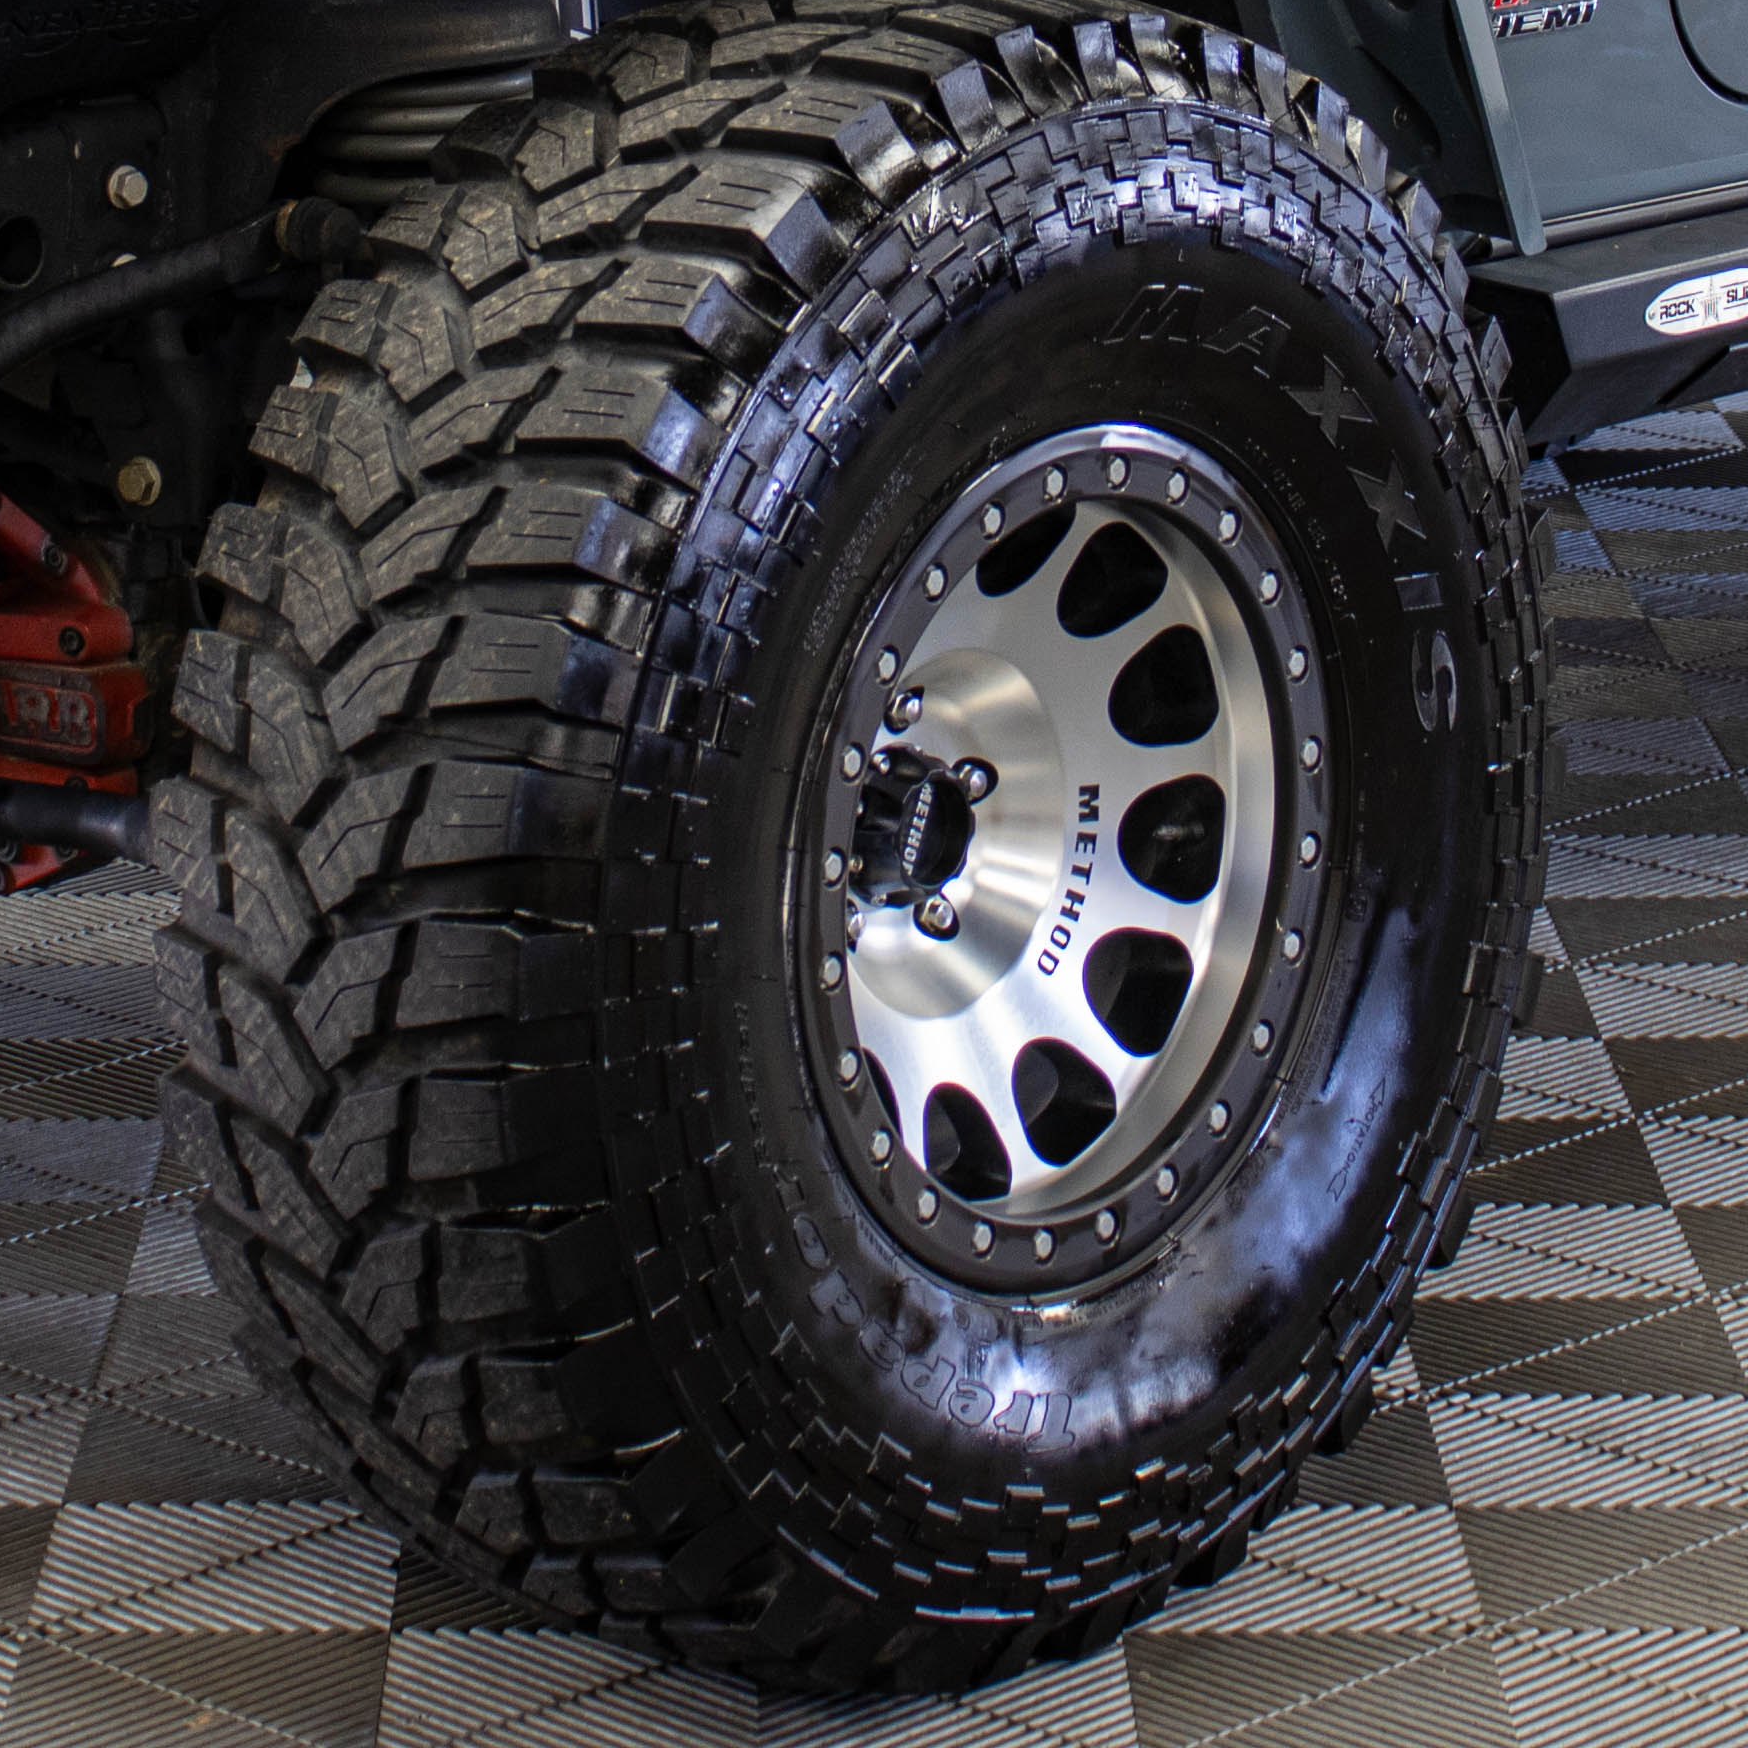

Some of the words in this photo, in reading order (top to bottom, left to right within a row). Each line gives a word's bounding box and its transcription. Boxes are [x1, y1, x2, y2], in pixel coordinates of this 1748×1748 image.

[1660, 299, 1695, 320] ROCK
[1100, 283, 1458, 734] MAXXIS
[1038, 784, 1100, 976] METHOD
